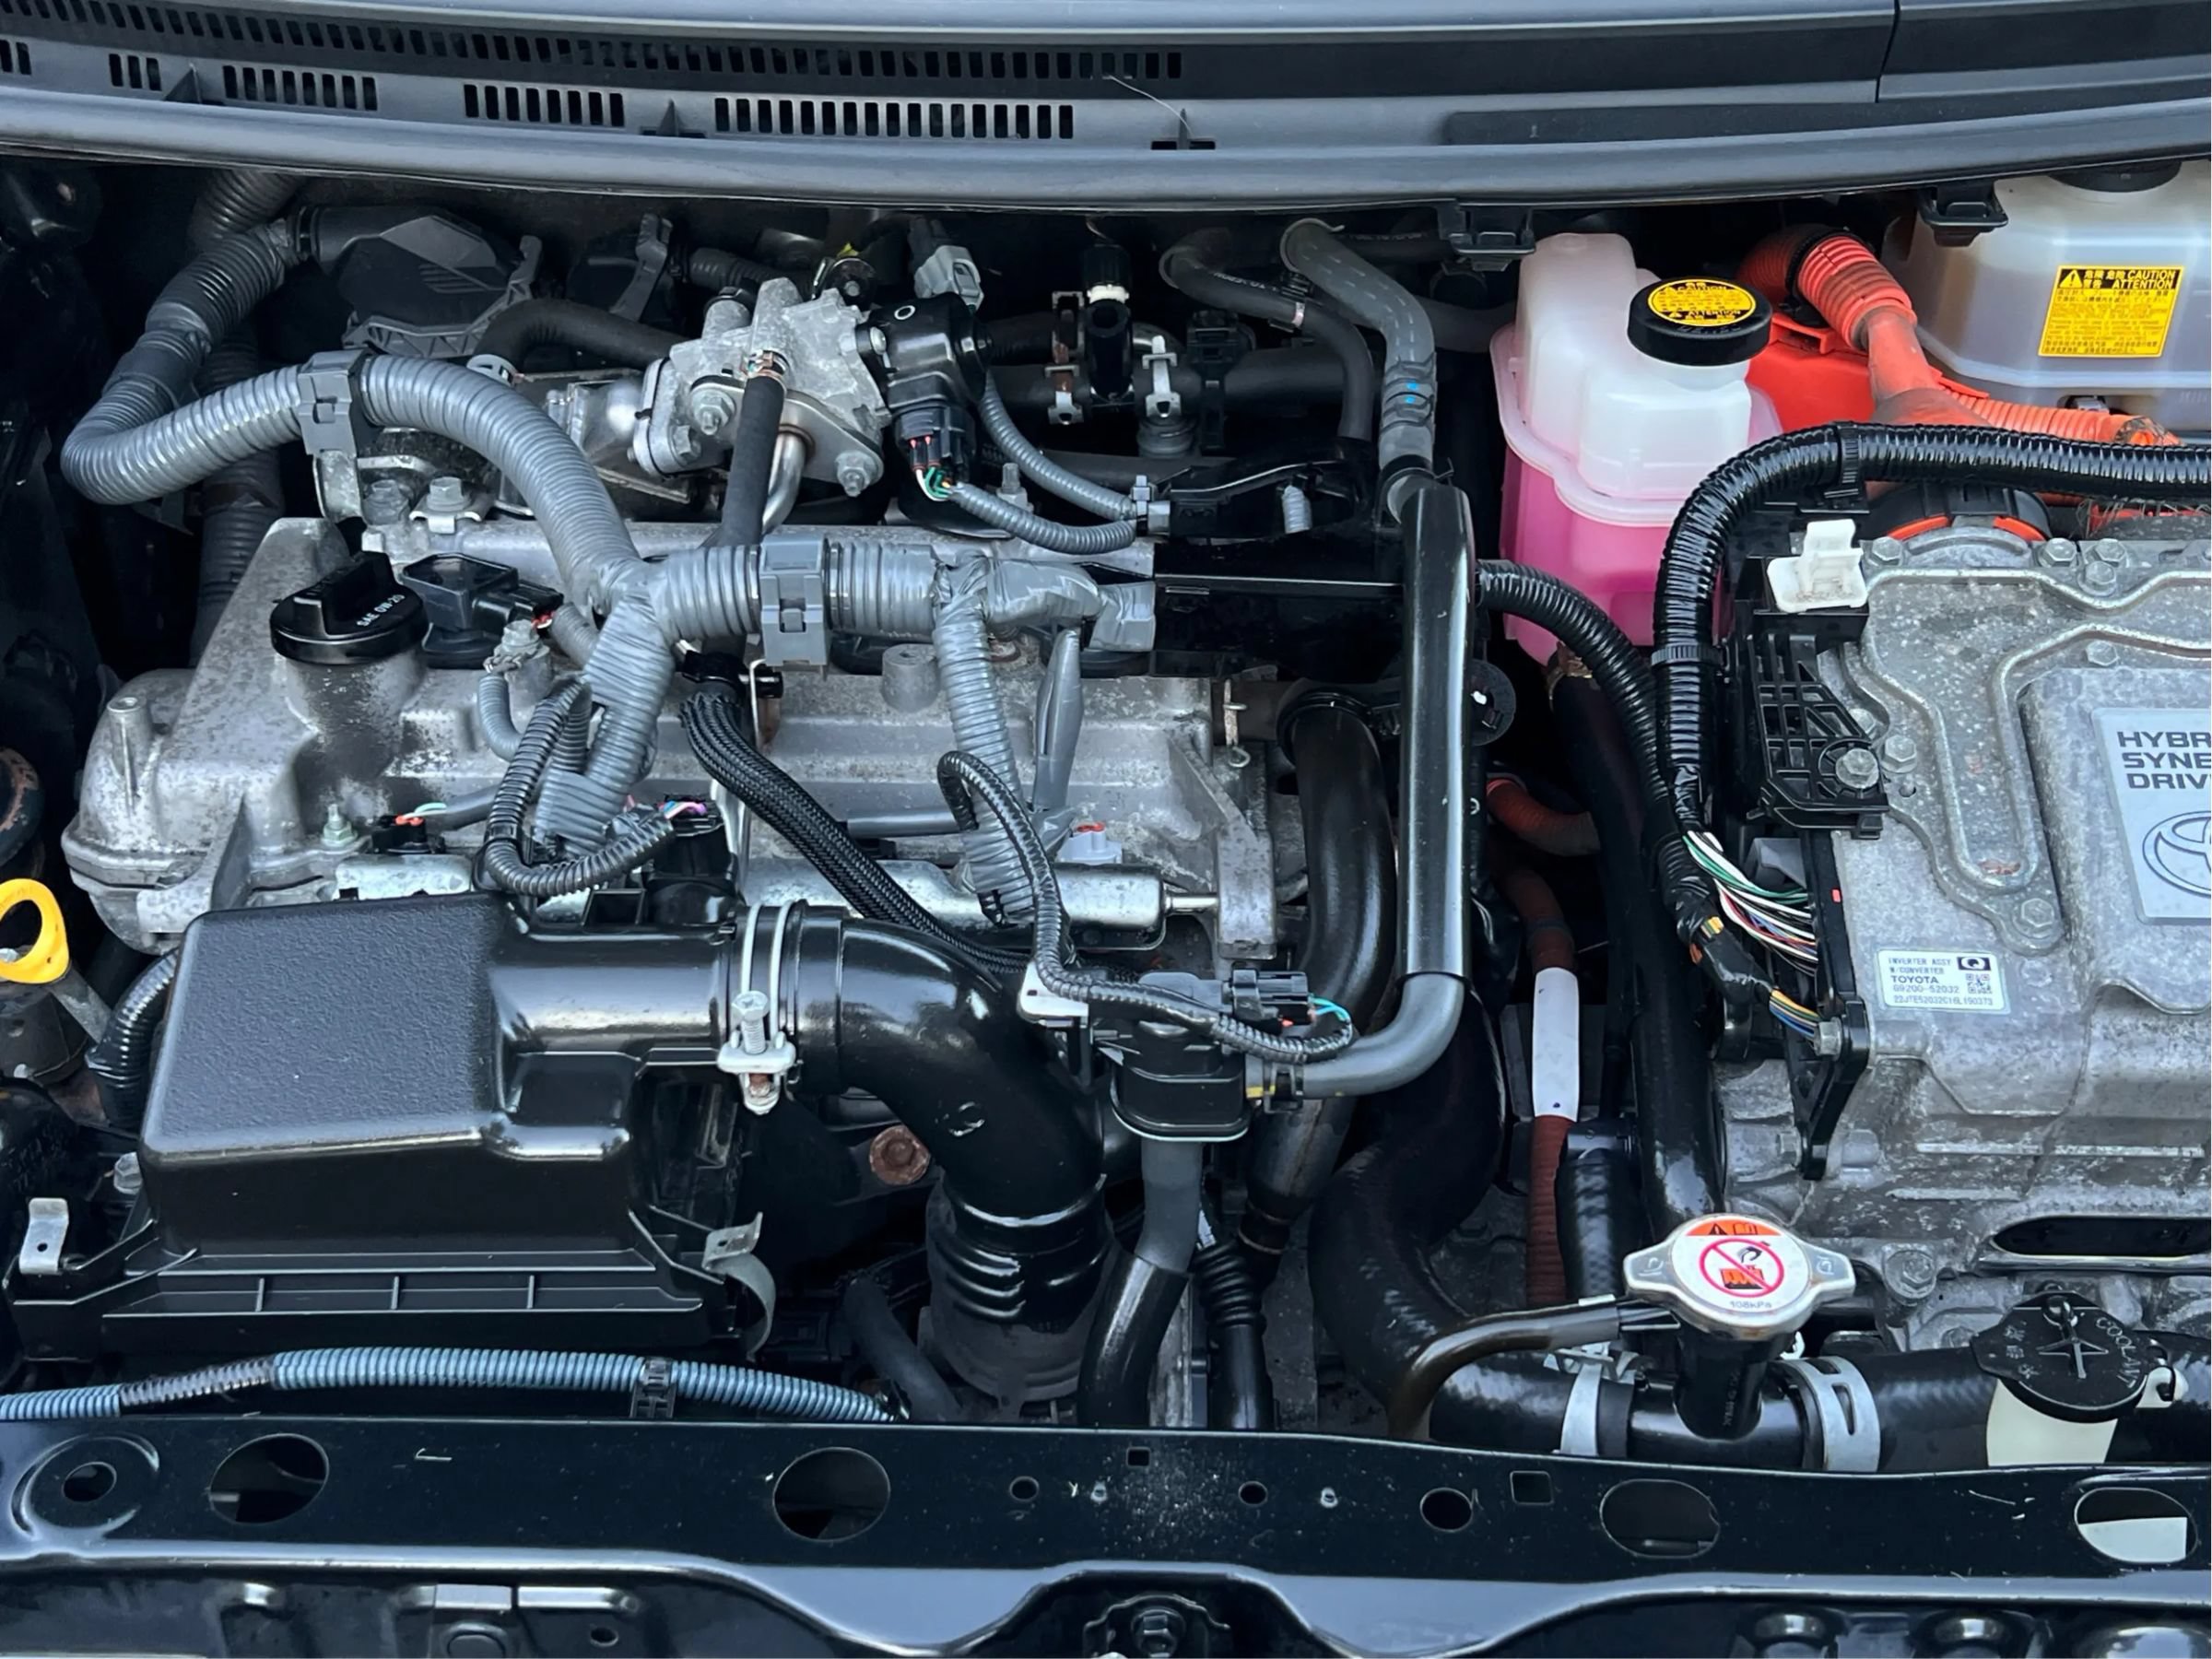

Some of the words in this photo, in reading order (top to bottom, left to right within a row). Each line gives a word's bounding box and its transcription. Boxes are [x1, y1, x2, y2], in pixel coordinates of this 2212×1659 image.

[2127, 270, 2176, 279] CAUTION
[2112, 279, 2173, 288] ATTENTION
[356, 612, 380, 627] SAE
[2117, 731, 2211, 747] HYBR
[2122, 752, 2211, 769] SYNE
[1888, 958, 1927, 966] INVERTER
[1891, 975, 1939, 983] TOYOTA
[2095, 1316, 2142, 1389] COOLANT
